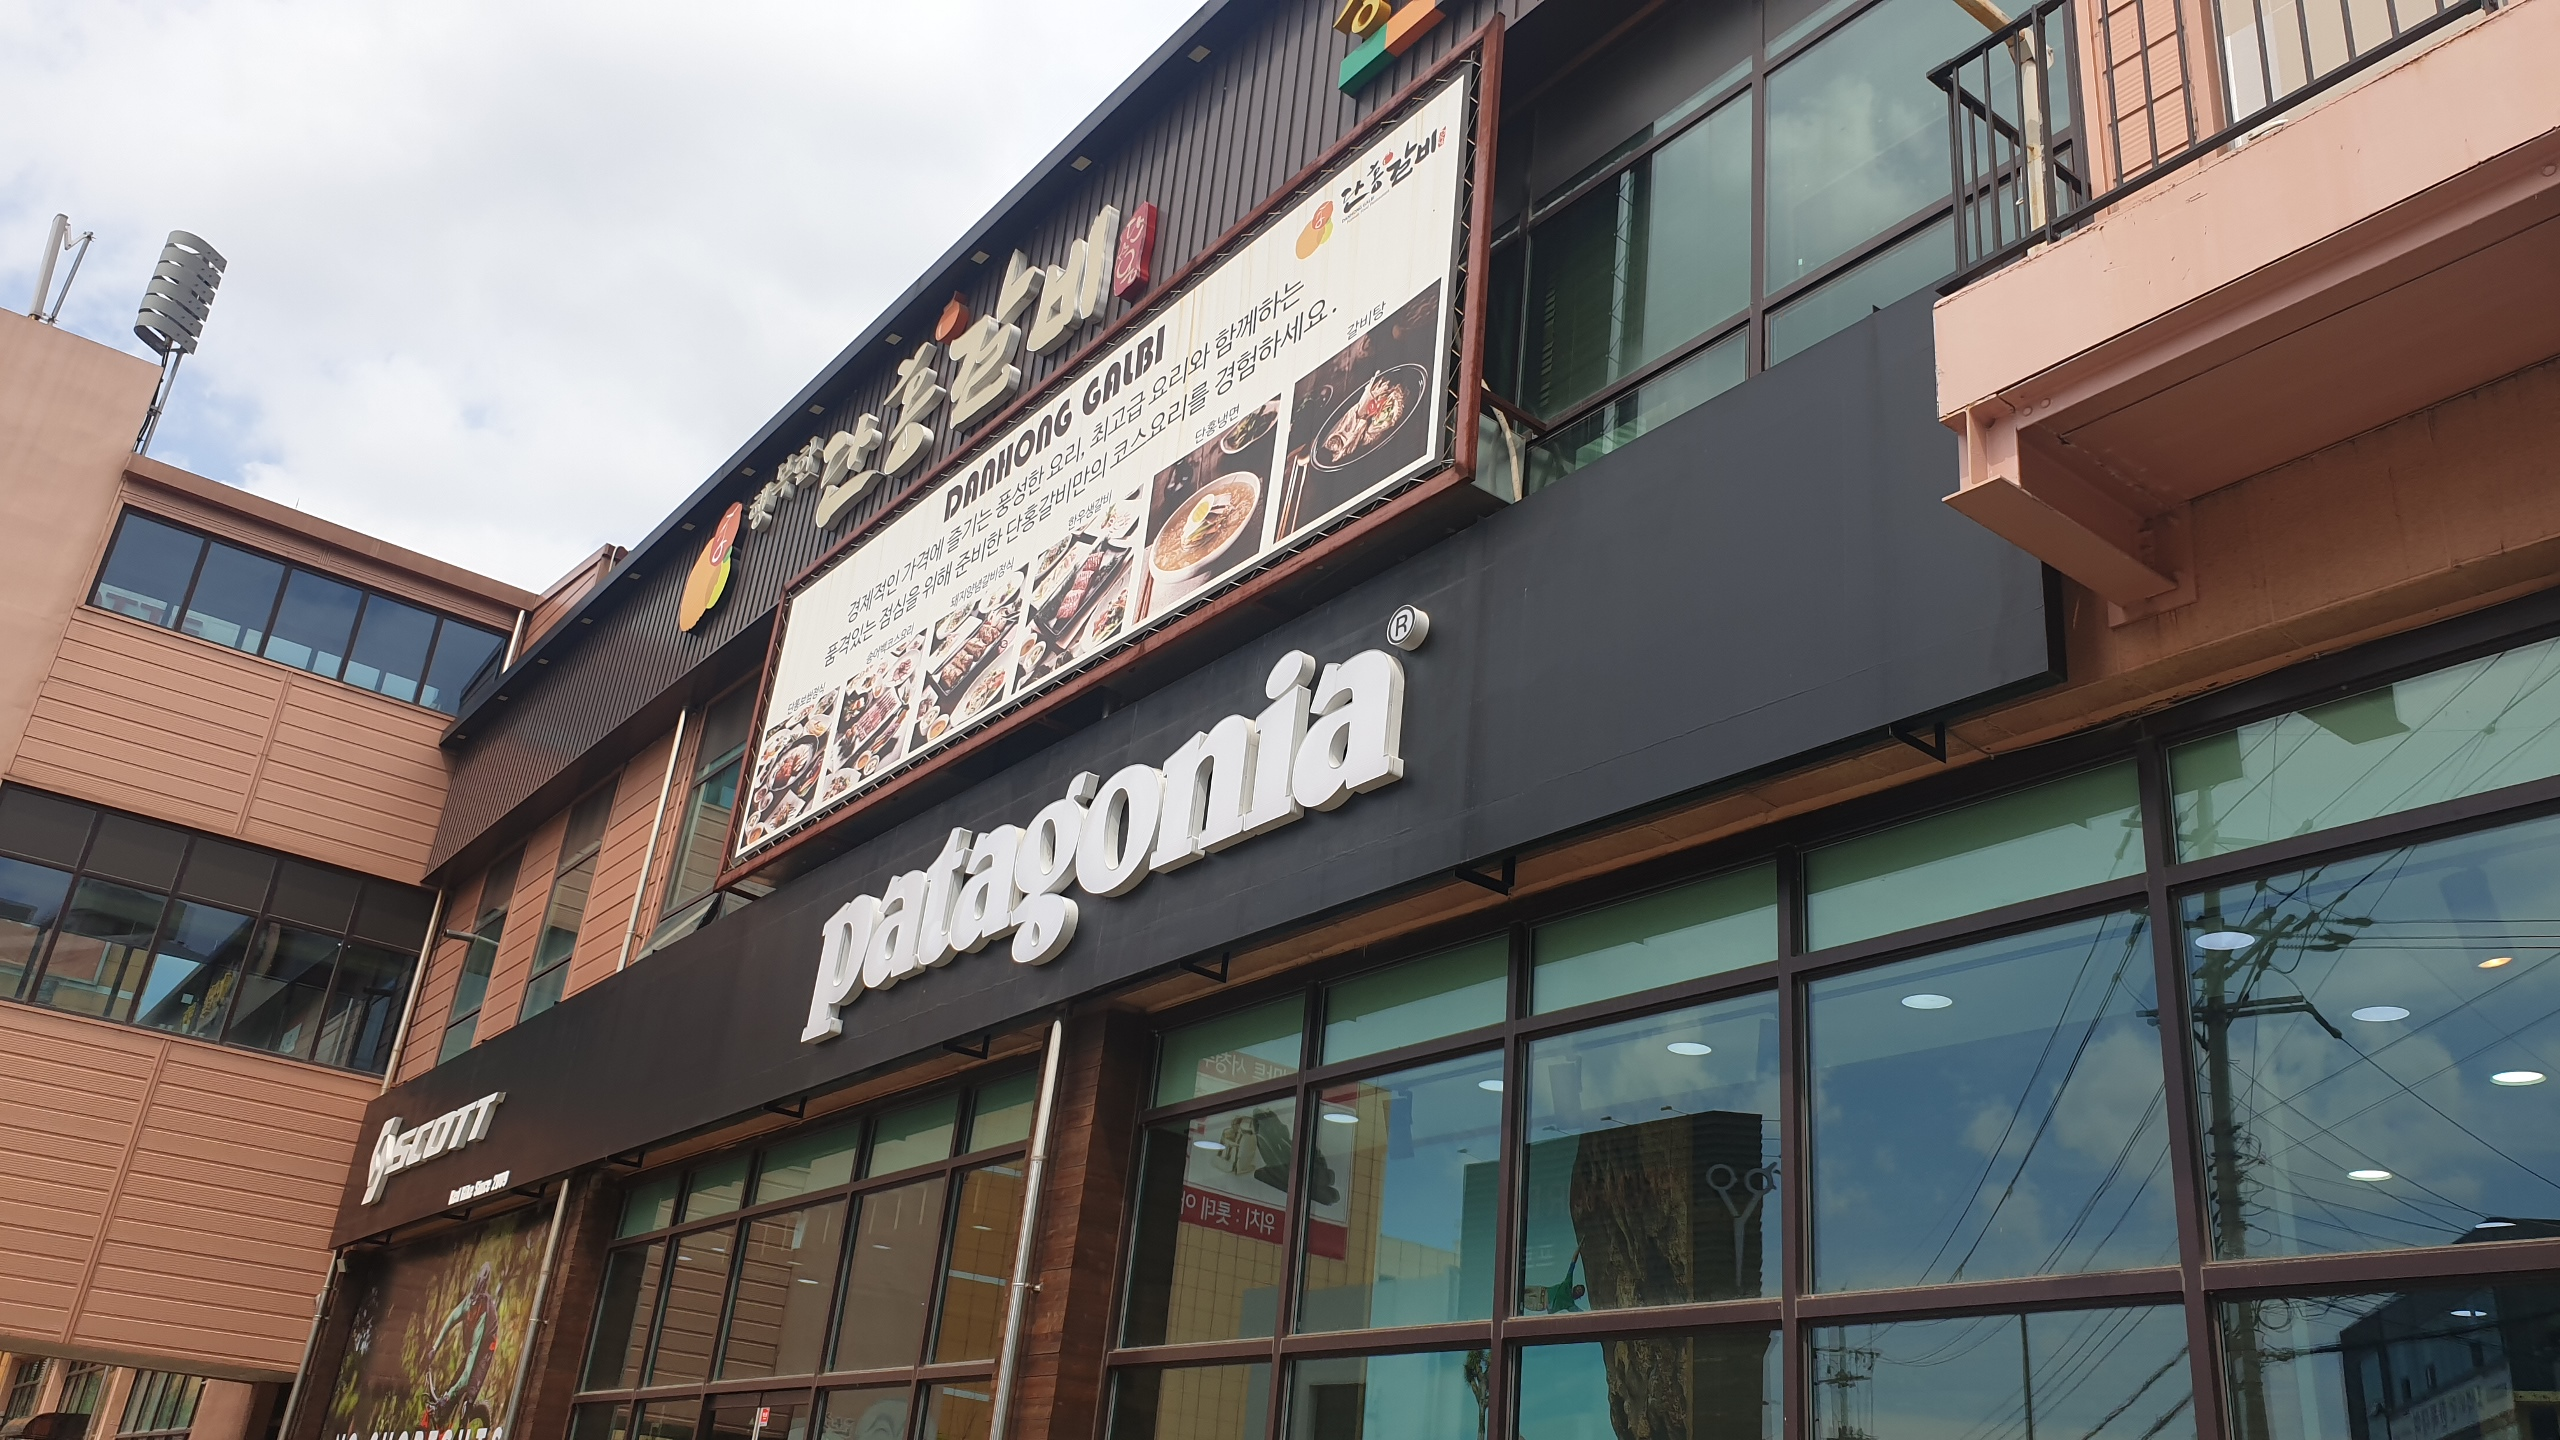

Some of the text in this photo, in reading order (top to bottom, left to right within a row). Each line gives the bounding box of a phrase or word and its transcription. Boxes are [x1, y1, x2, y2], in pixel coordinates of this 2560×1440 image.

[1341, 128, 1438, 213] 단홍갈비
[1347, 301, 1386, 340] 갈비탕
[816, 204, 1120, 528] 단홍갈비
[847, 280, 1305, 623] 경제적인 가격에 즐기는 풍성한 요리, 최고급 요리와 함께하는
[944, 324, 1165, 522] DANHONG GALBI
[1195, 404, 1240, 445] 단홍냉면
[824, 299, 1338, 667] 품격있는 점심을 위해 준비한 단홍갈비만의 코스요리를 경험하세요.
[1068, 489, 1113, 531] 한우생갈비
[950, 556, 1015, 608] 돼지양념갈비정식
[801, 649, 1404, 1045] patagonia
[384, 1091, 506, 1176] SCOTT
